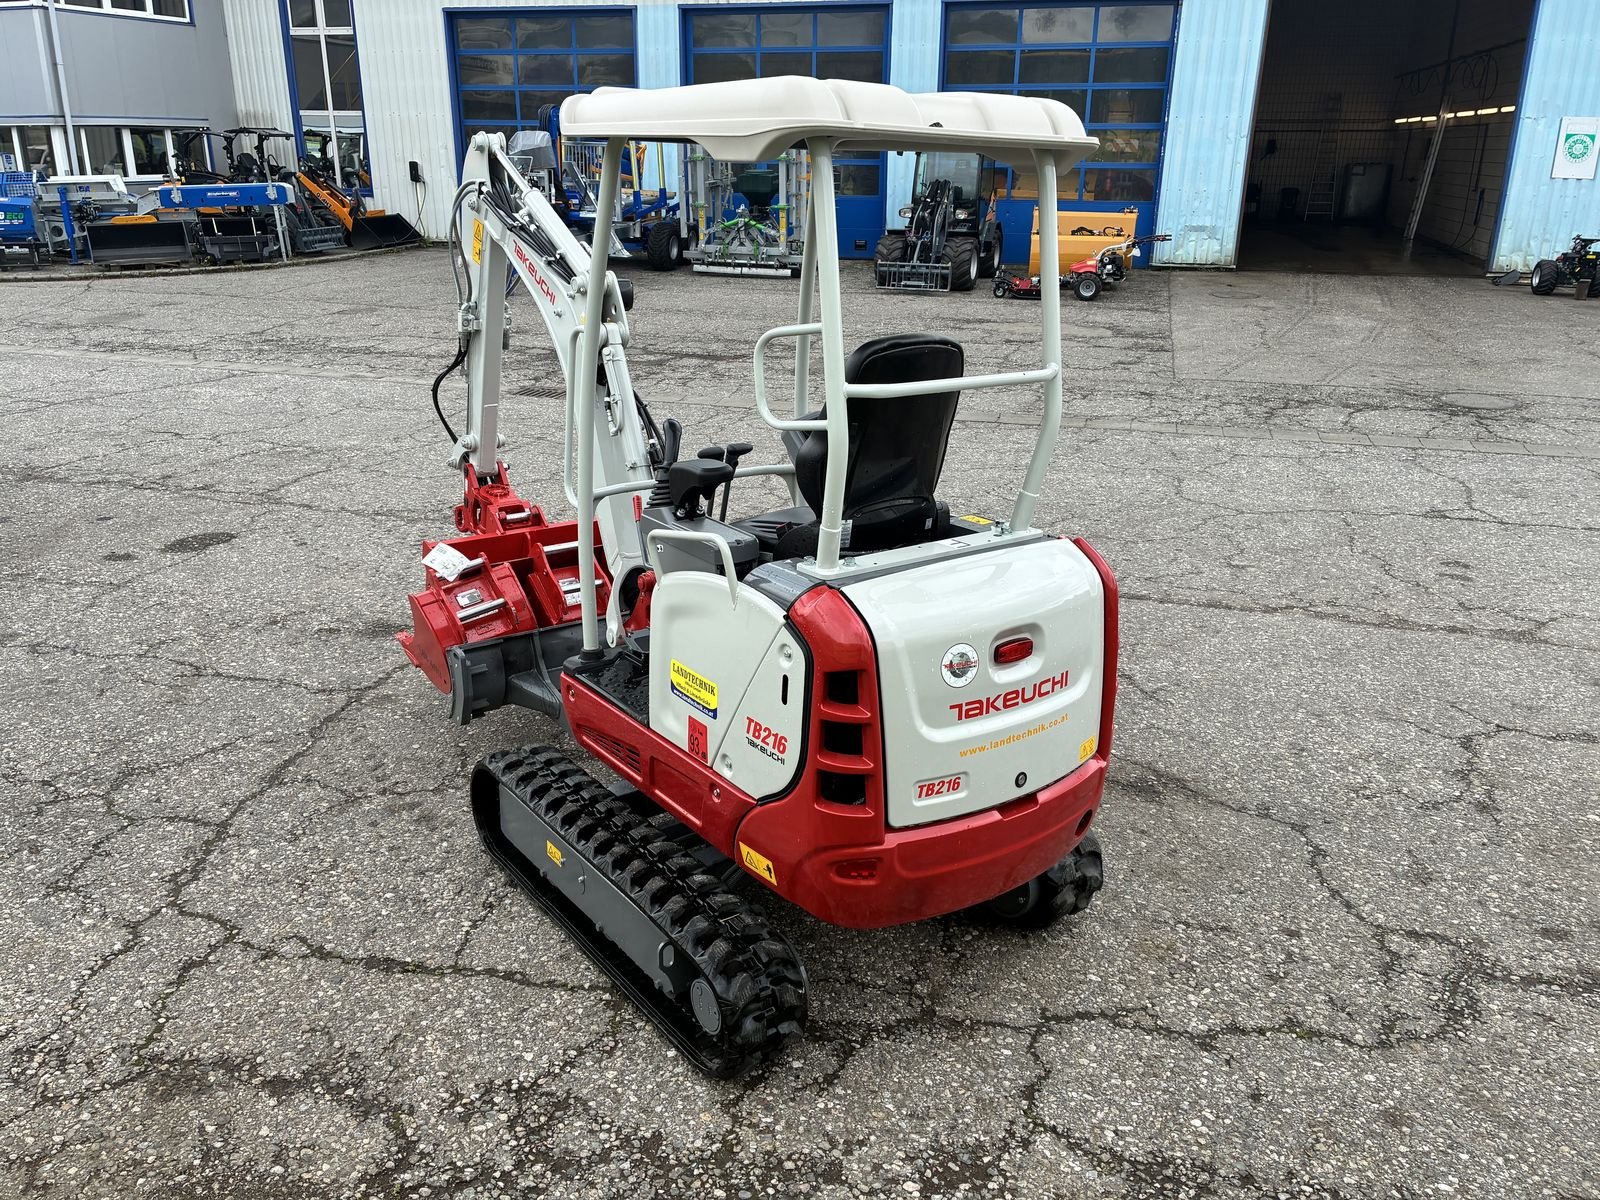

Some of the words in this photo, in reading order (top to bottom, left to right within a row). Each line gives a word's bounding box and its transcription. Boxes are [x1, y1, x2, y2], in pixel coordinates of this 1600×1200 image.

[6, 212, 24, 220] ECO
[512, 239, 556, 305] TAKEUCHI
[672, 663, 716, 697] LANDTECHNIK
[949, 670, 1069, 721] TAKEUCHI
[690, 733, 700, 756] 93
[745, 736, 785, 766] TAKEUCHI
[746, 716, 788, 755] TB216
[960, 713, 1069, 758] www.landtechnik.co.at
[917, 776, 962, 799] TB216
